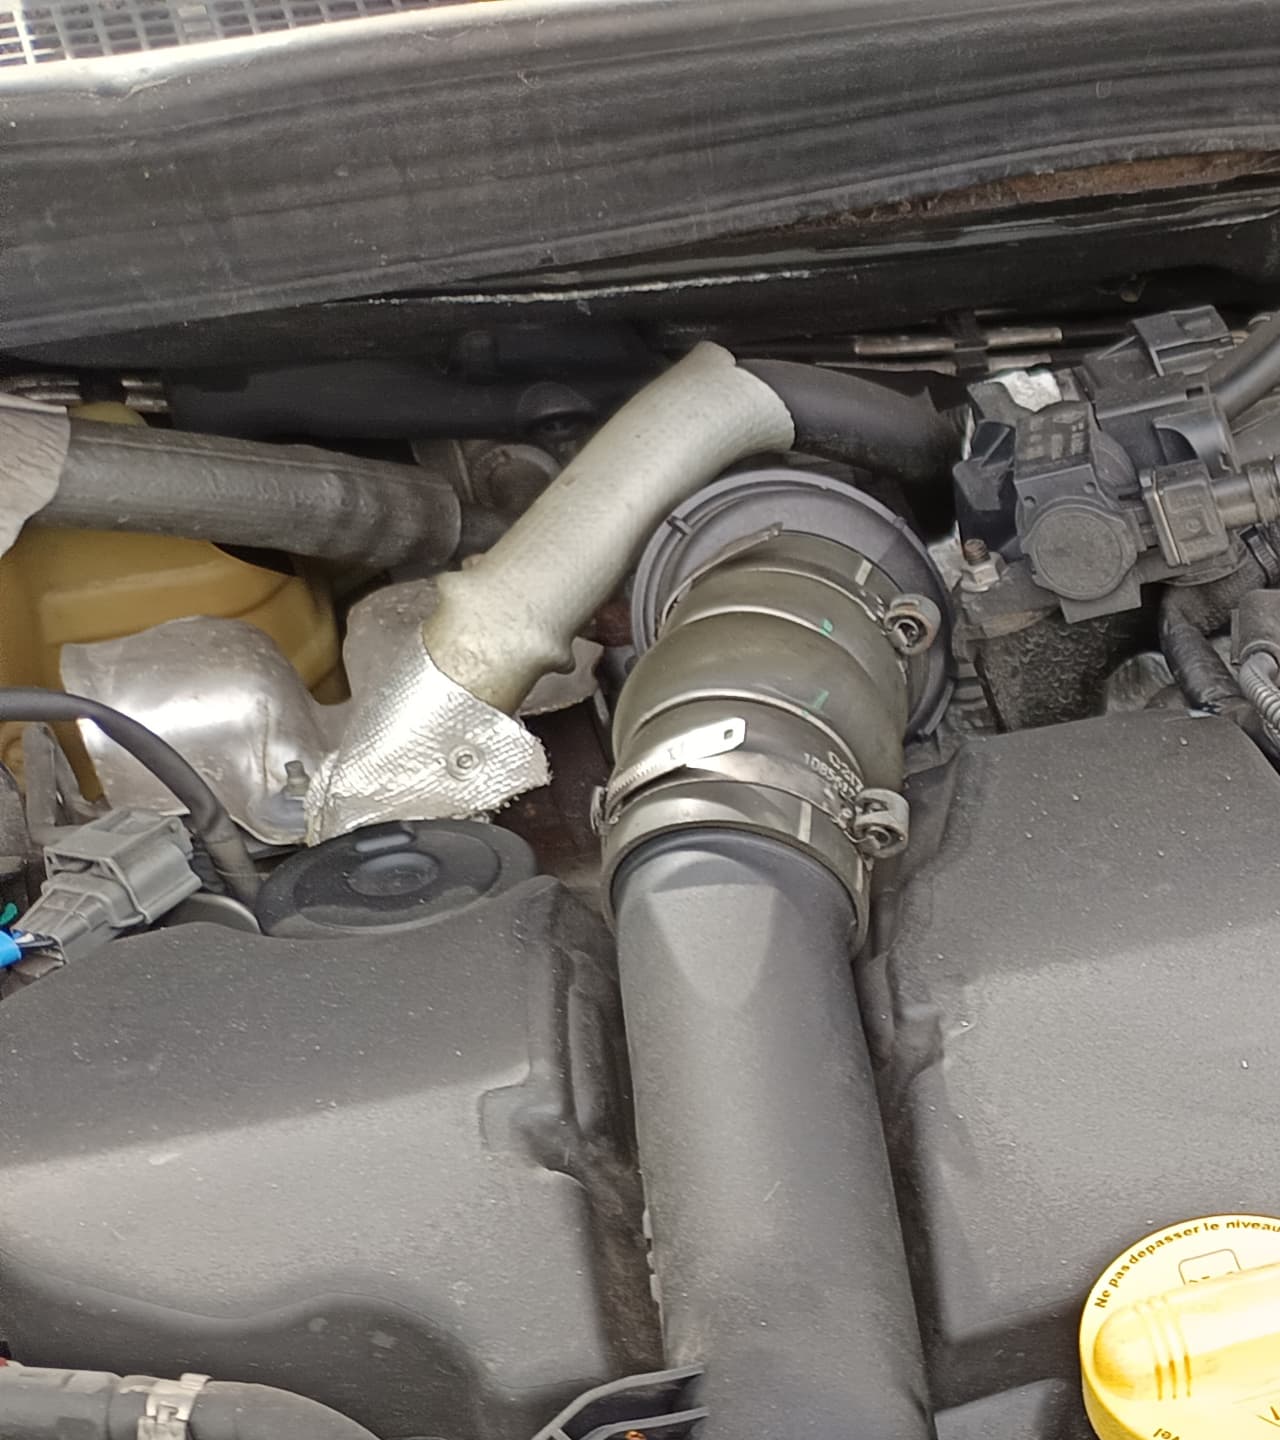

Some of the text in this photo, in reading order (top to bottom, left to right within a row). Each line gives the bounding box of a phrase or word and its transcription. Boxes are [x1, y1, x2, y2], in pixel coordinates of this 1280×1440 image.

[1094, 1290, 1111, 1308] Ne
[1108, 1265, 1130, 1288] pas
[1204, 1222, 1219, 1231] le
